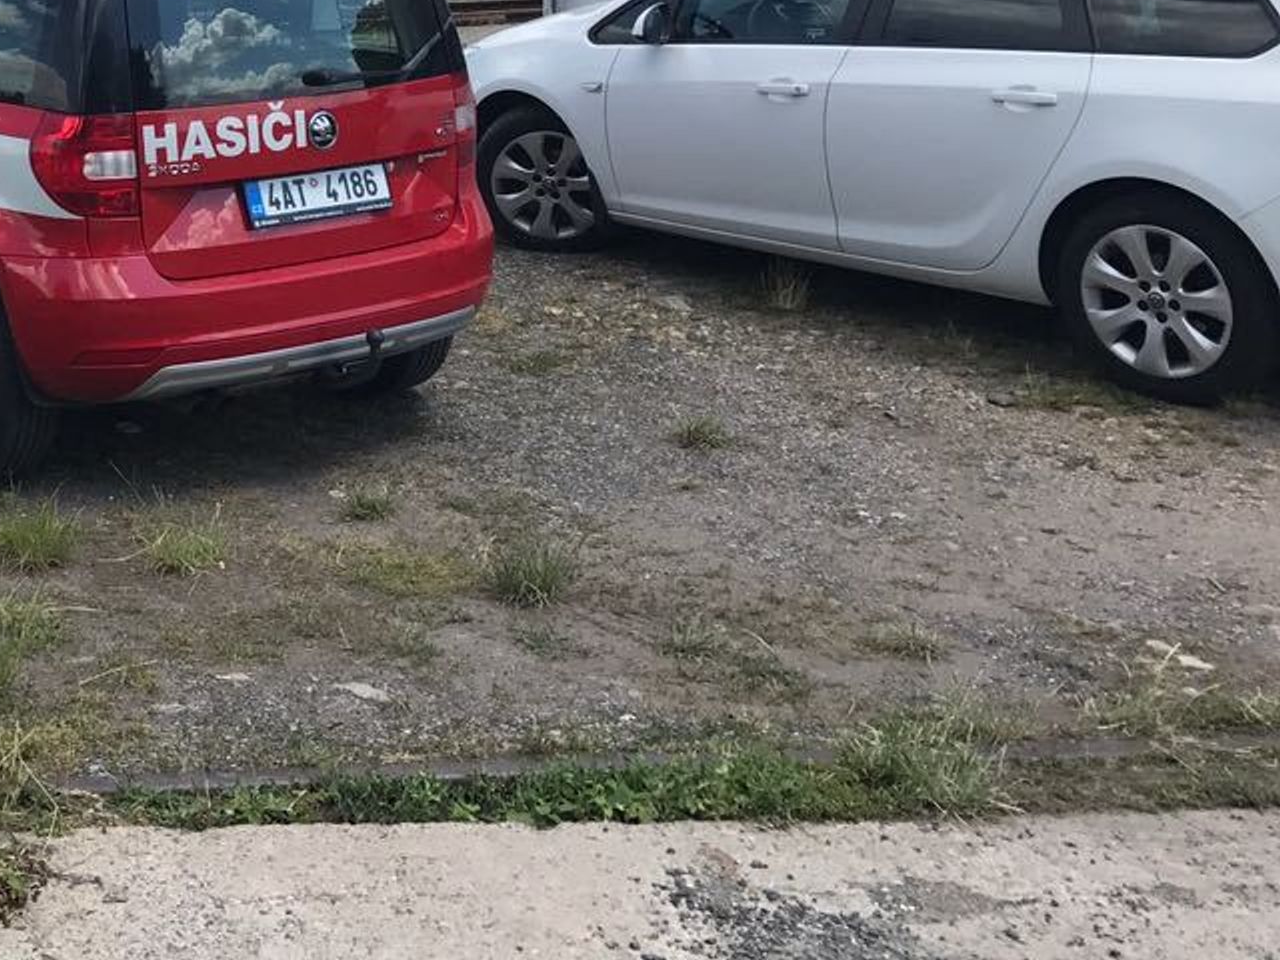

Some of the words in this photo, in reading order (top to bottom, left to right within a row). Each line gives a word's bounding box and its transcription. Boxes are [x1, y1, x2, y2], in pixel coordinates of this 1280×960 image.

[142, 100, 309, 164] HASIČI
[269, 178, 306, 210] 4AT
[326, 169, 378, 202] 4186
